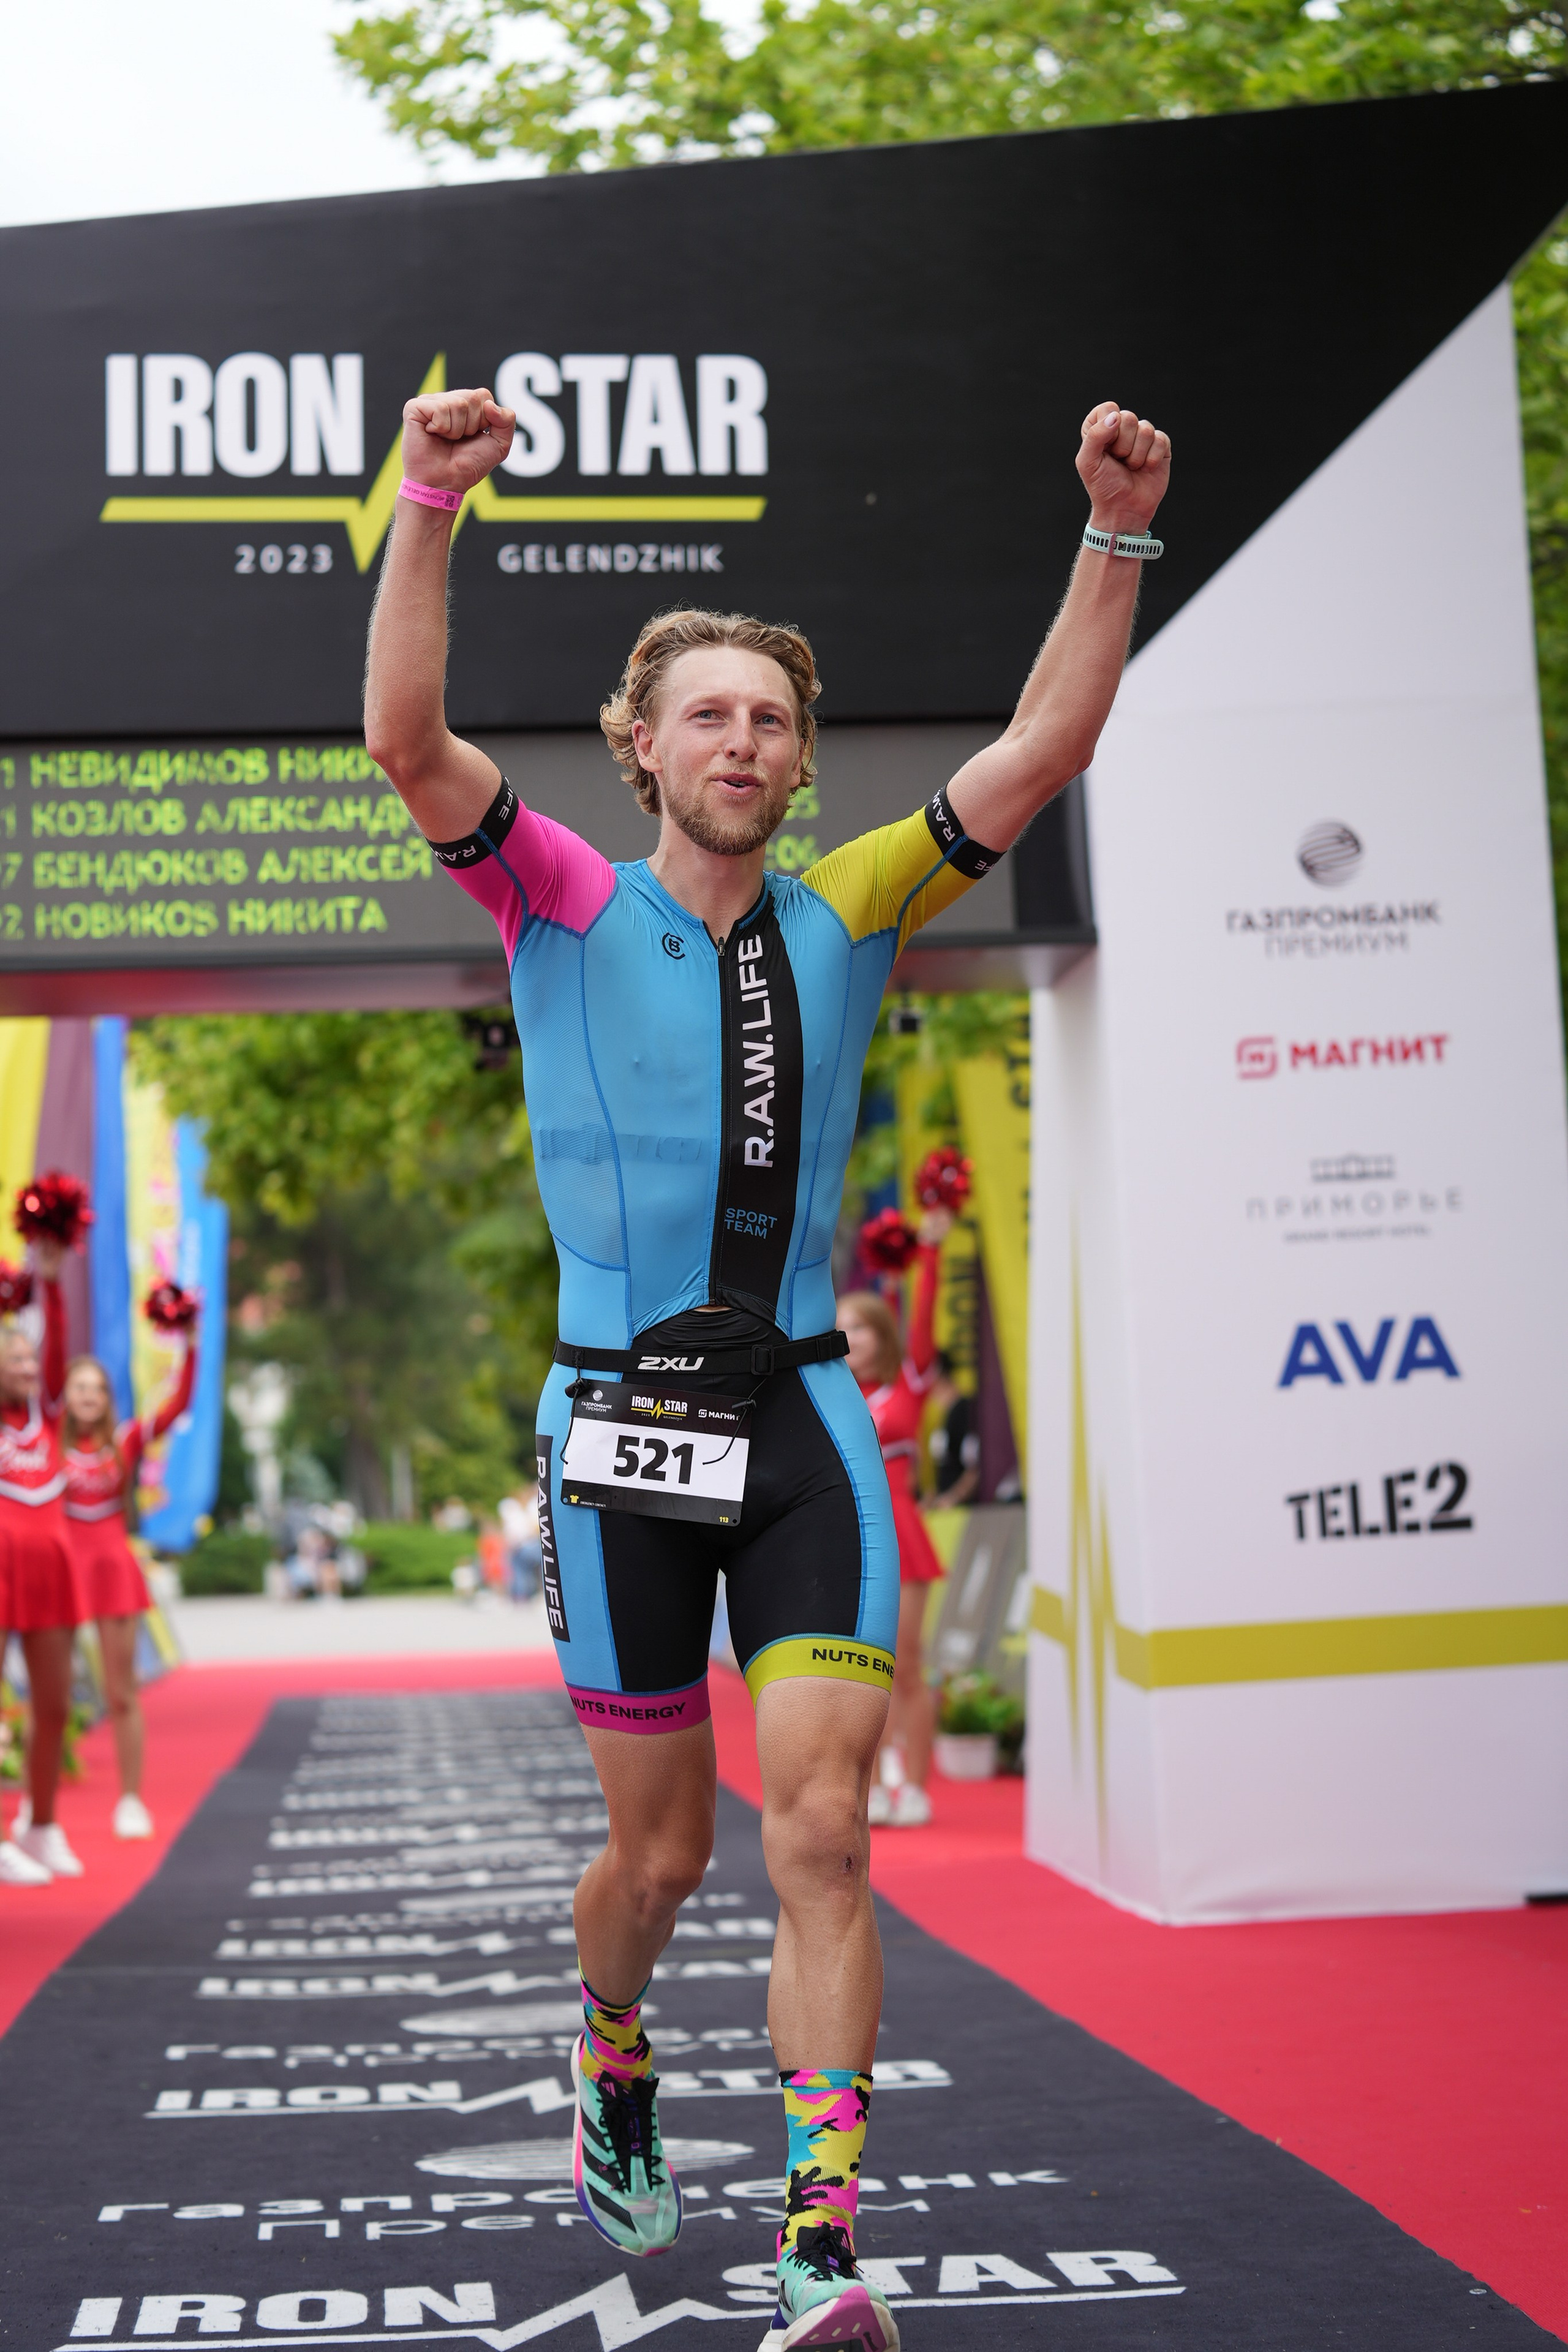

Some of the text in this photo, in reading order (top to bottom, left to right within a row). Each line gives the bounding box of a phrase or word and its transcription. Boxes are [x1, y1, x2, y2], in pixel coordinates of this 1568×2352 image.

[105, 352, 768, 477] IRON STAR
[235, 545, 333, 574] 2023
[497, 543, 725, 573] GELENDZHIK
[32, 798, 187, 839] КОЗЛОВ
[33, 848, 248, 896] БЕНДЮКОВ
[257, 835, 433, 884] АЛЕКСЕЙ
[227, 895, 388, 936] НИКИТА
[1226, 899, 1441, 933] ГАЗПРОМБАНК
[737, 934, 774, 1168] R.A.W.LIFE
[1289, 1034, 1449, 1069] МАГНИТ
[724, 1219, 767, 1240] TEAM
[725, 1207, 778, 1229] SPORT
[638, 1355, 705, 1371] 2XU
[1278, 1315, 1462, 1389] AVA
[581, 1401, 612, 1409] ГАЗПРОМБАНК
[631, 1395, 688, 1413] IRON STAR
[613, 1434, 694, 1485] 521
[1285, 1461, 1474, 1541] TELE2
[812, 1648, 869, 1667] NUTS
[570, 1695, 686, 1721] NUTS ENERGY
[155, 2080, 462, 2111] IRON
[70, 2282, 497, 2337] IRON
